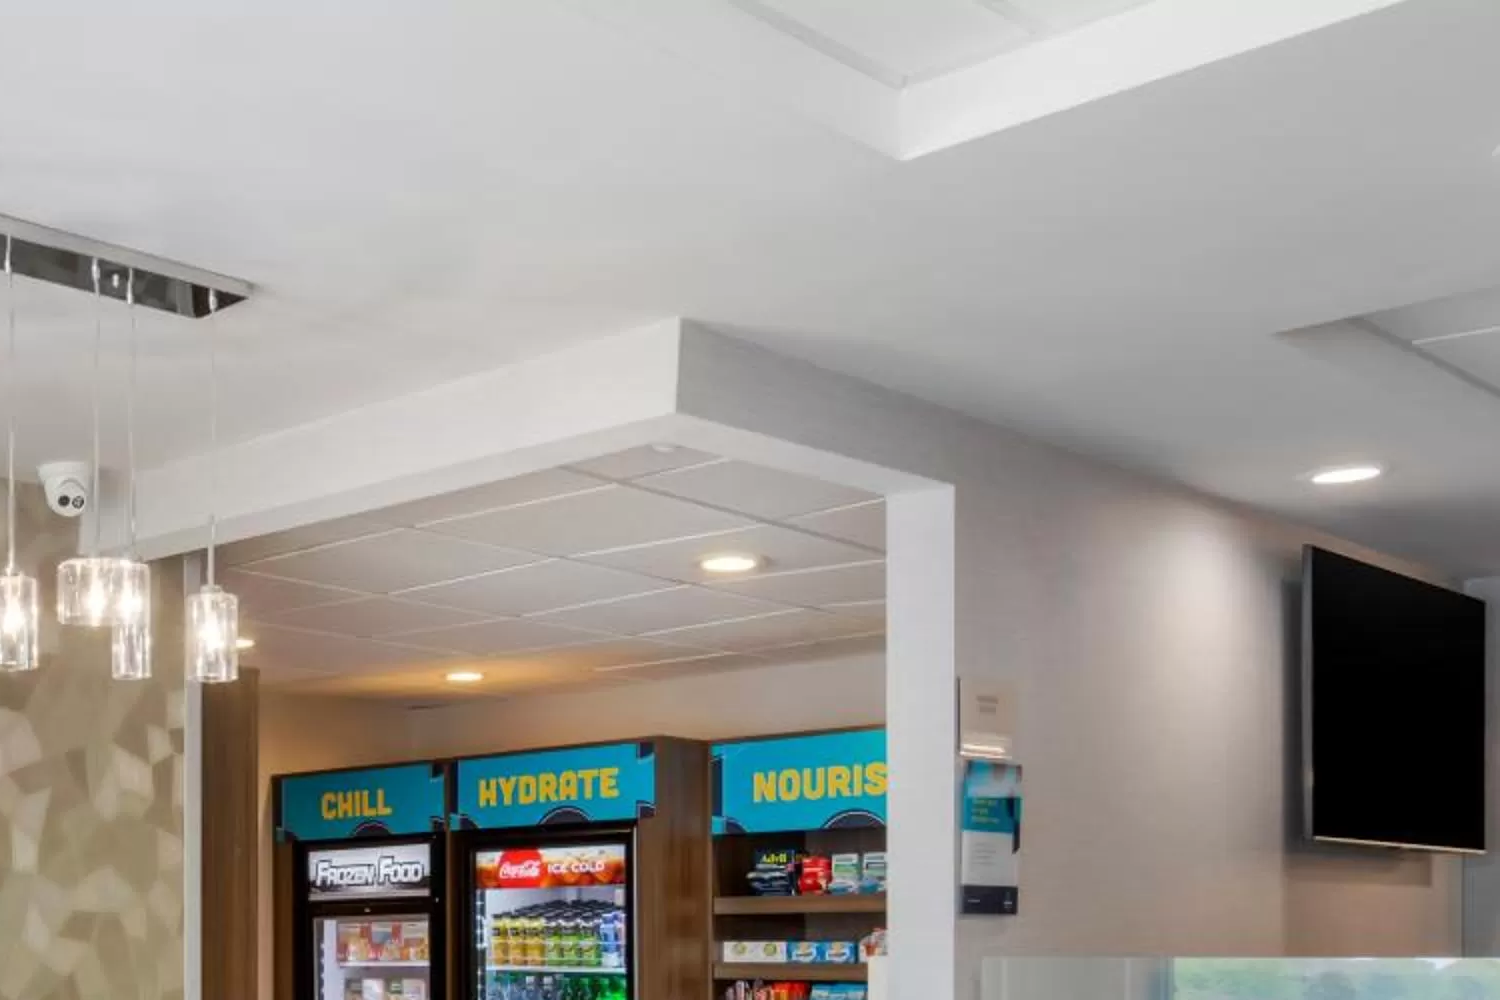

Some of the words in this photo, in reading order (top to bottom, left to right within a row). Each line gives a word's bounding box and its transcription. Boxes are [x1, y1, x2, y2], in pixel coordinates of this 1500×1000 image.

[478, 767, 620, 808] HYDRATE
[321, 789, 392, 820] CHILL
[571, 859, 605, 873] COLD
